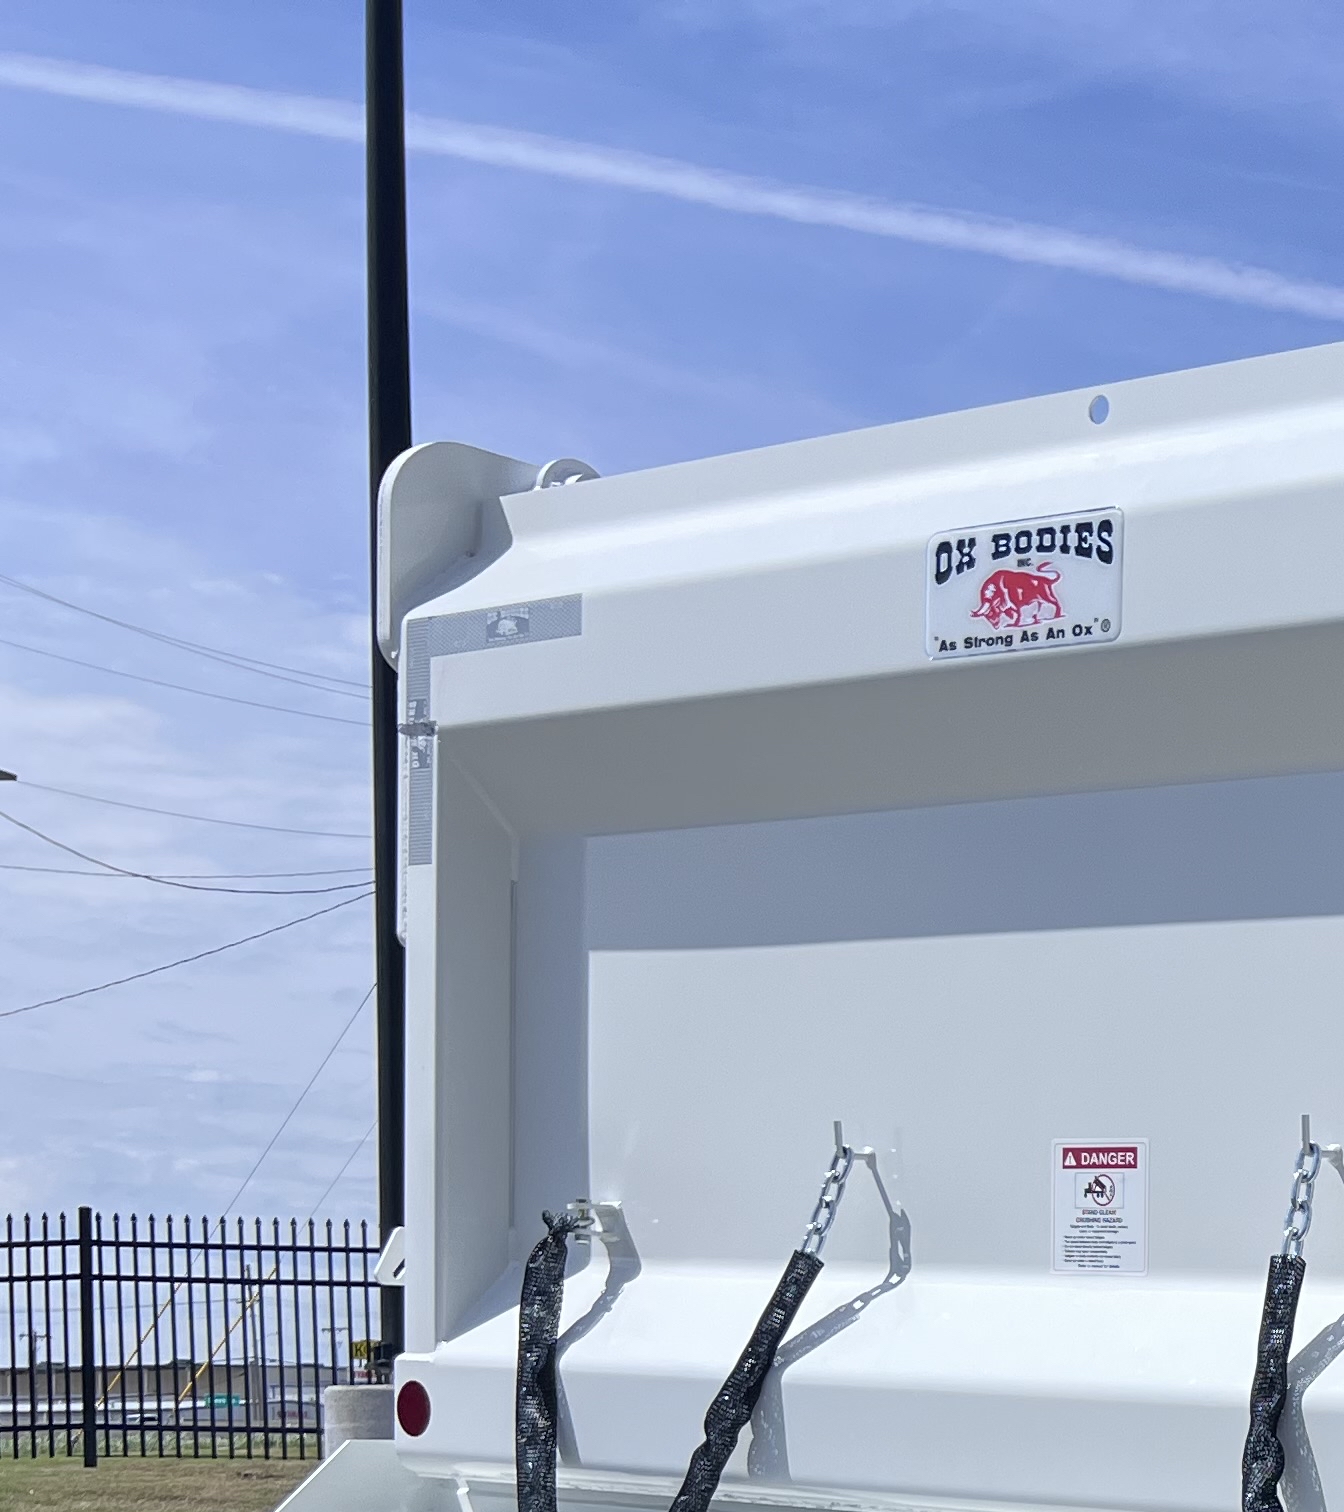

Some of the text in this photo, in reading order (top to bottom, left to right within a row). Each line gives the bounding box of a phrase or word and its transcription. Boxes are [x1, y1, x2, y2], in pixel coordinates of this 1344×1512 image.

[935, 519, 1114, 585] OX BODIES
[964, 634, 1014, 649] Strong
[1020, 631, 1039, 643] As
[1046, 628, 1065, 640] An
[1081, 1152, 1135, 1166] DANGER
